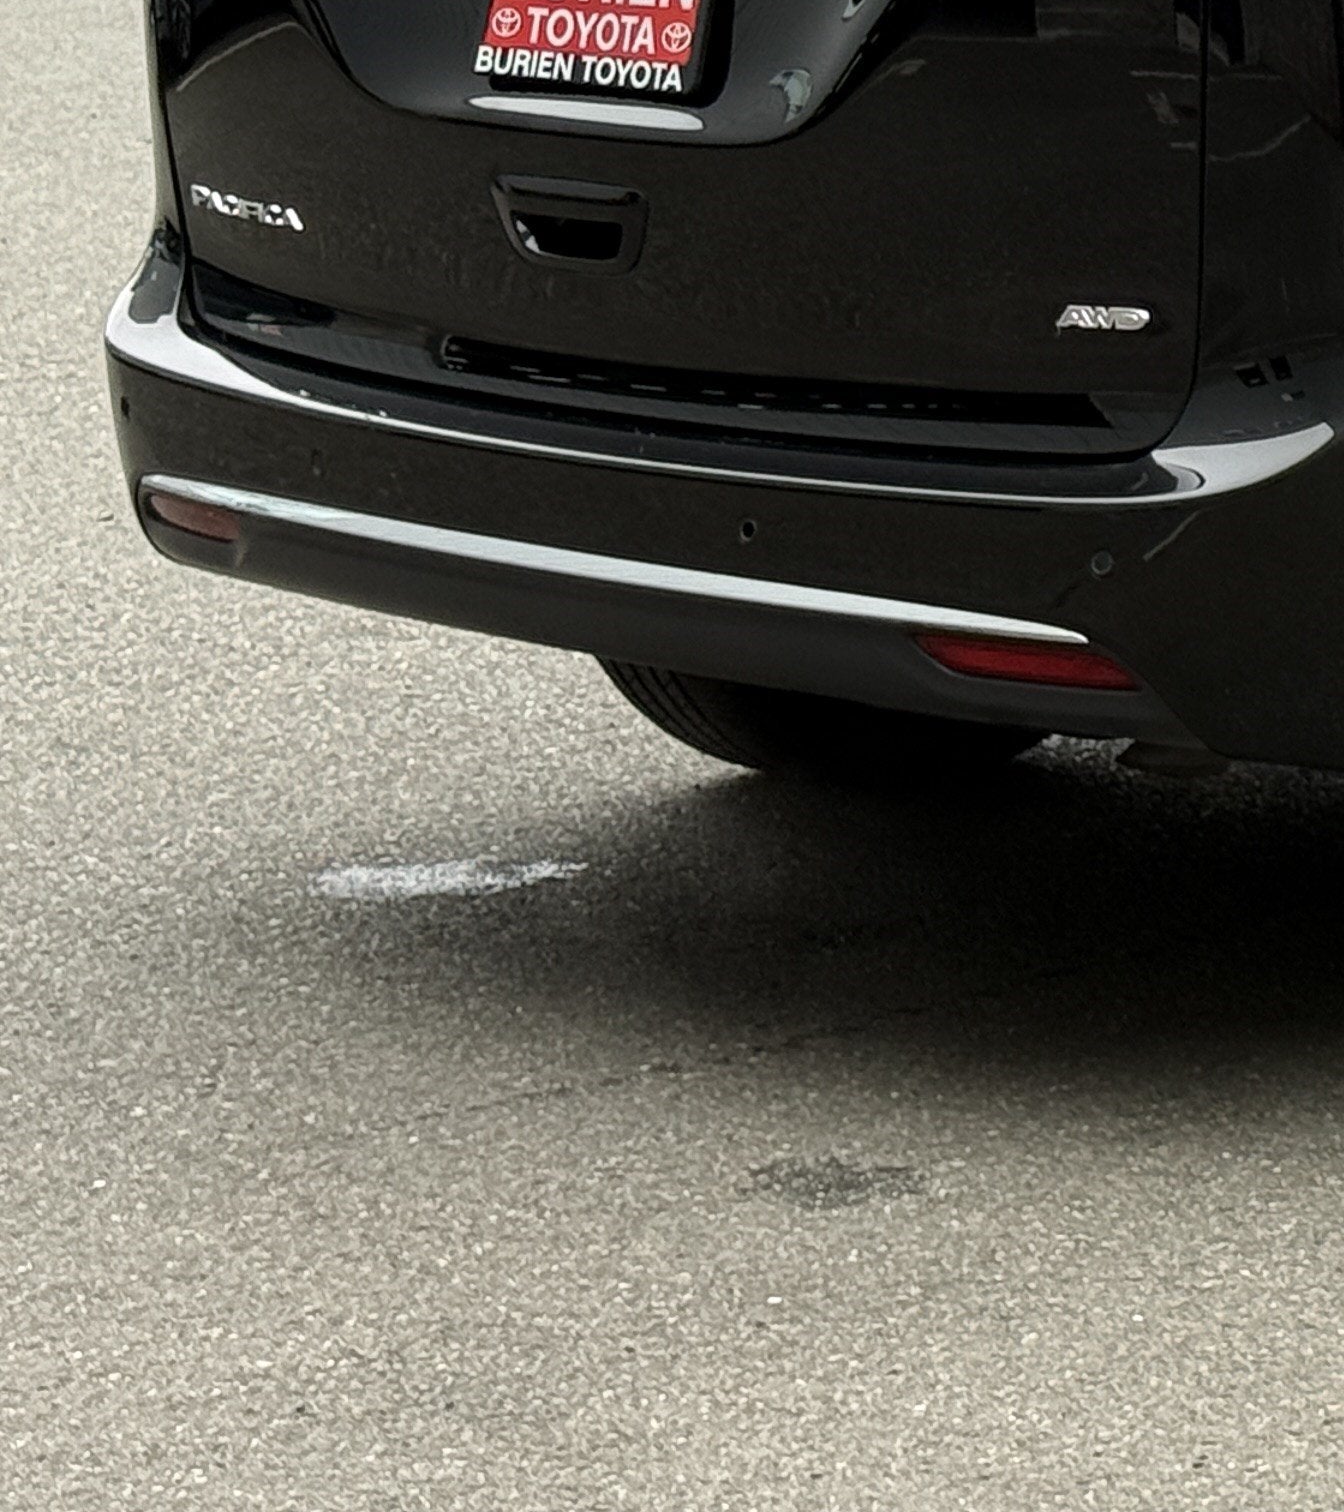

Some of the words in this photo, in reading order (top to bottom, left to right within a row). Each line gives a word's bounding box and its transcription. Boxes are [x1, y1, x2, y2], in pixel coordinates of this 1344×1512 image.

[527, 6, 656, 54] TOYOTA
[474, 44, 575, 81] BURIEN
[581, 56, 683, 92] TOYOTA
[1055, 304, 1150, 330] AWD
